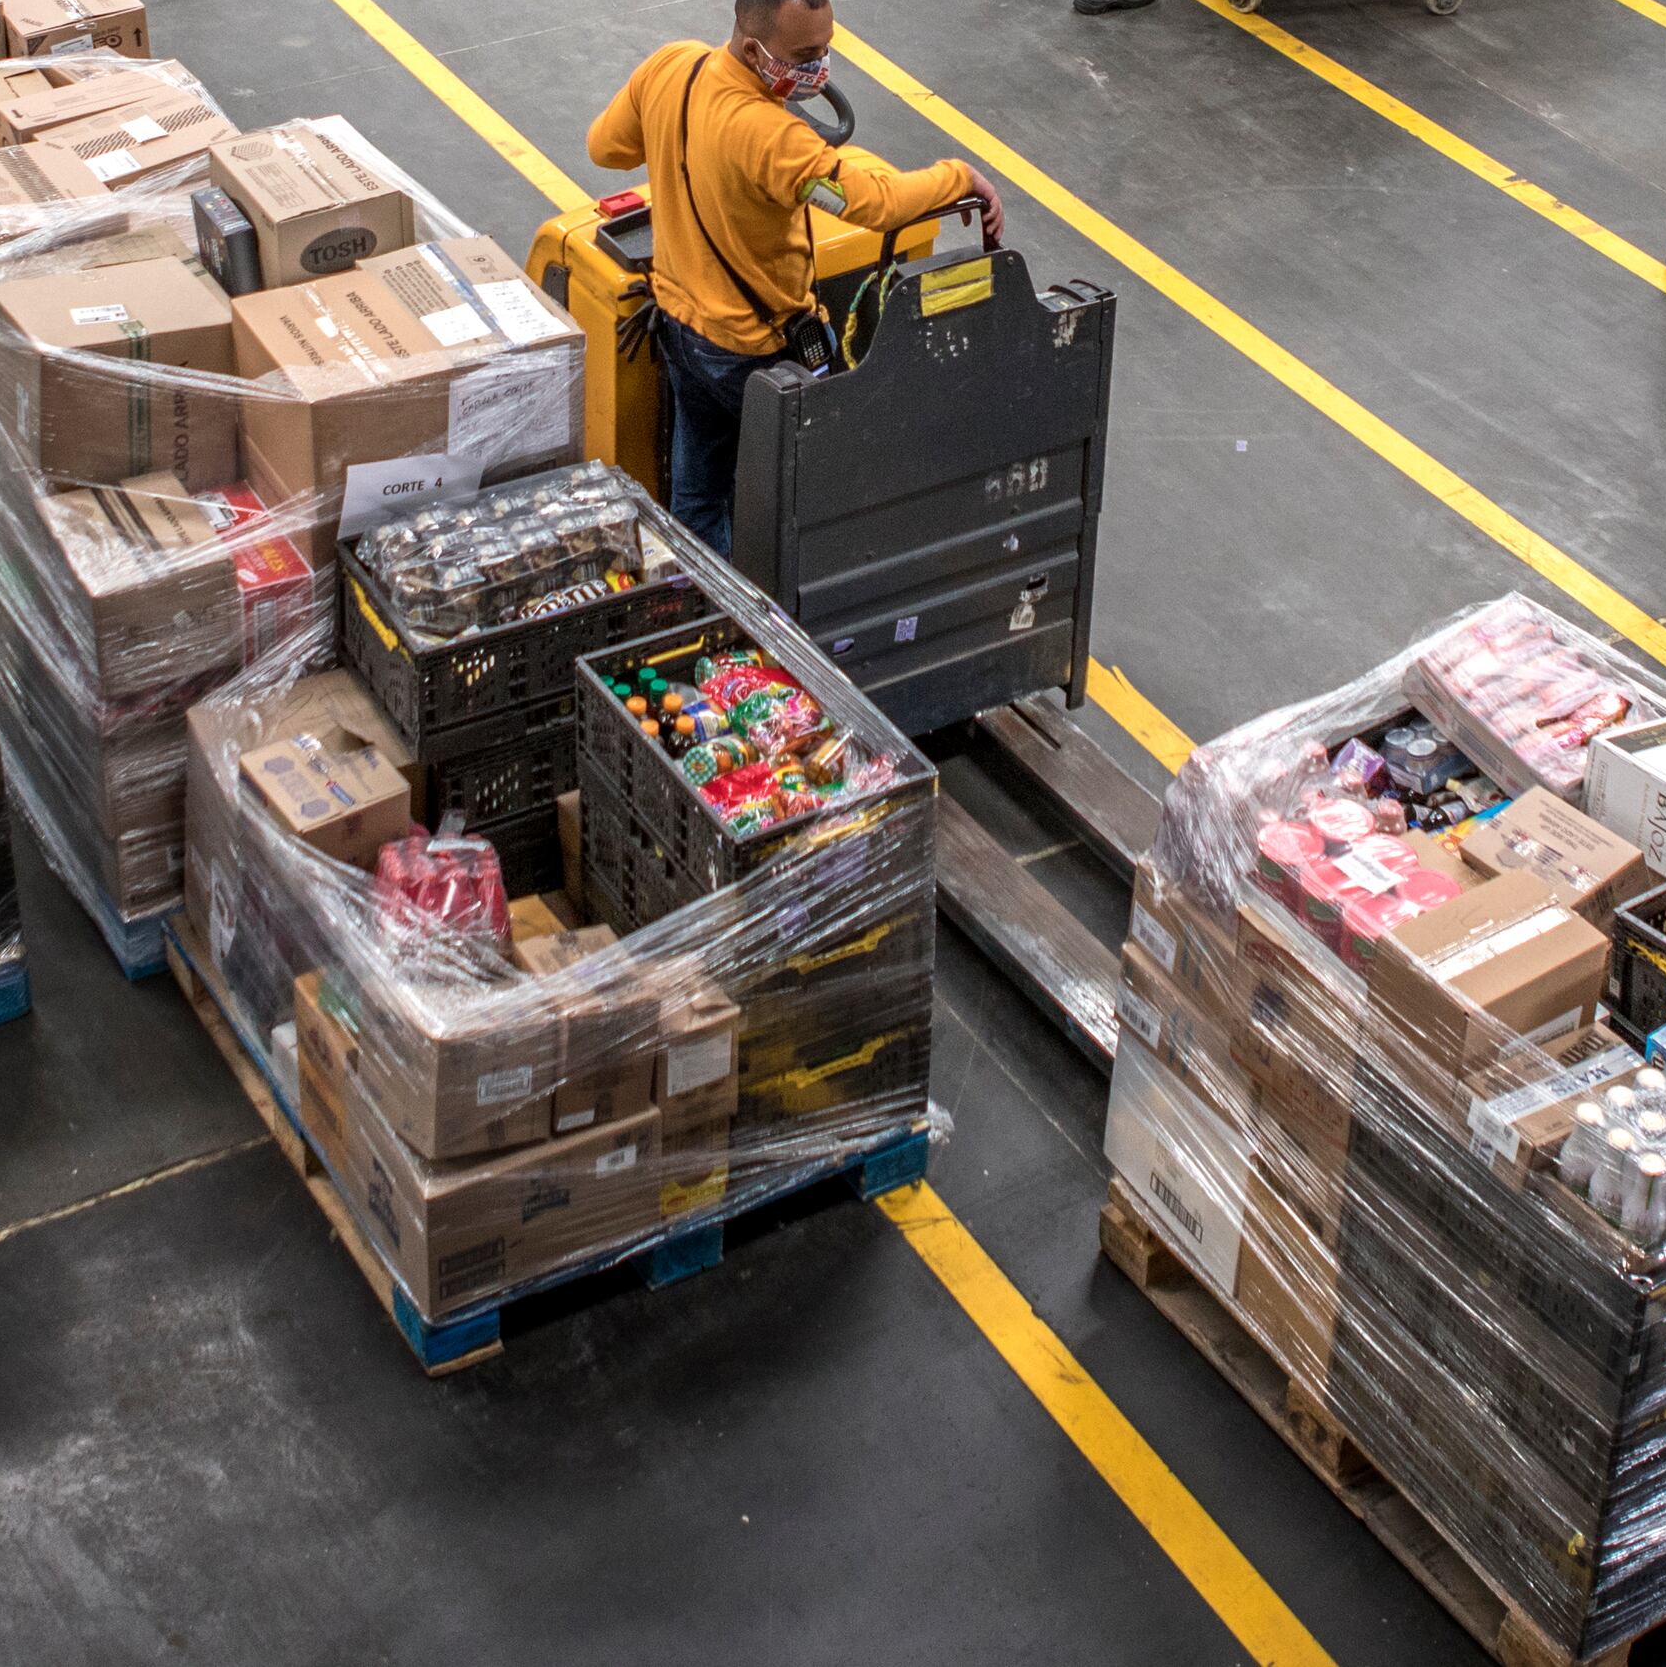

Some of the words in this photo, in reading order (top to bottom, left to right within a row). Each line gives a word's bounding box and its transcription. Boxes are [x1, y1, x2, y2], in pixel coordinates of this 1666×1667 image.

[353, 168, 379, 191] ESTE
[309, 238, 367, 265] TOSH
[345, 290, 372, 319] ARRIBA
[368, 317, 390, 340] LADO
[172, 428, 190, 481] LADO
[382, 479, 425, 497] CORTE
